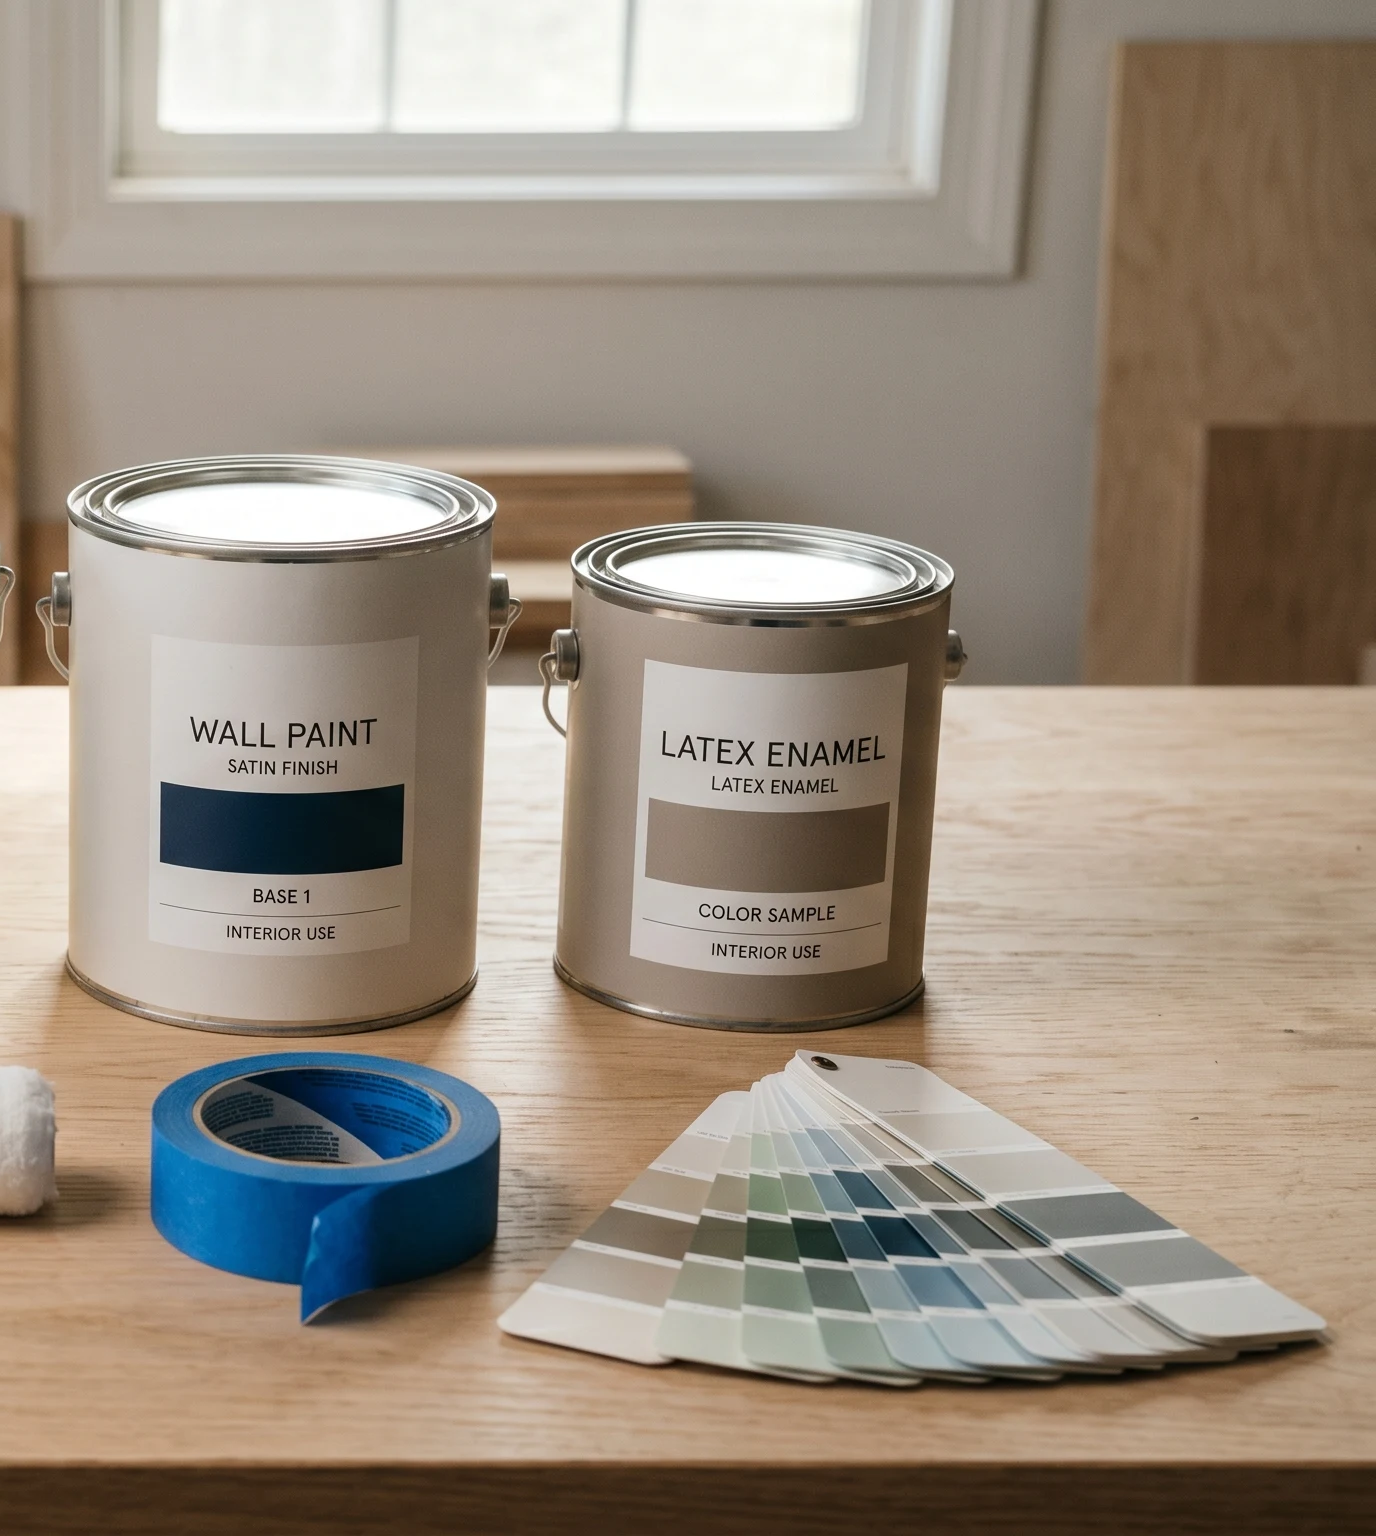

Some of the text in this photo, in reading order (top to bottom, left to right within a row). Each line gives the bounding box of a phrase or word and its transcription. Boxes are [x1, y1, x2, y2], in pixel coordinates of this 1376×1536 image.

[189, 715, 378, 749] WALL PAINT
[661, 730, 886, 768] LATEX ENAMEL
[227, 758, 338, 776] SATIN FINISH
[711, 775, 839, 795] LATEX ENAMEL
[253, 888, 311, 905] BASE 1
[698, 903, 836, 923] COLOR SAMPLE
[226, 924, 336, 941] INTERIOR USE
[711, 942, 822, 960] INTERIOR USE
